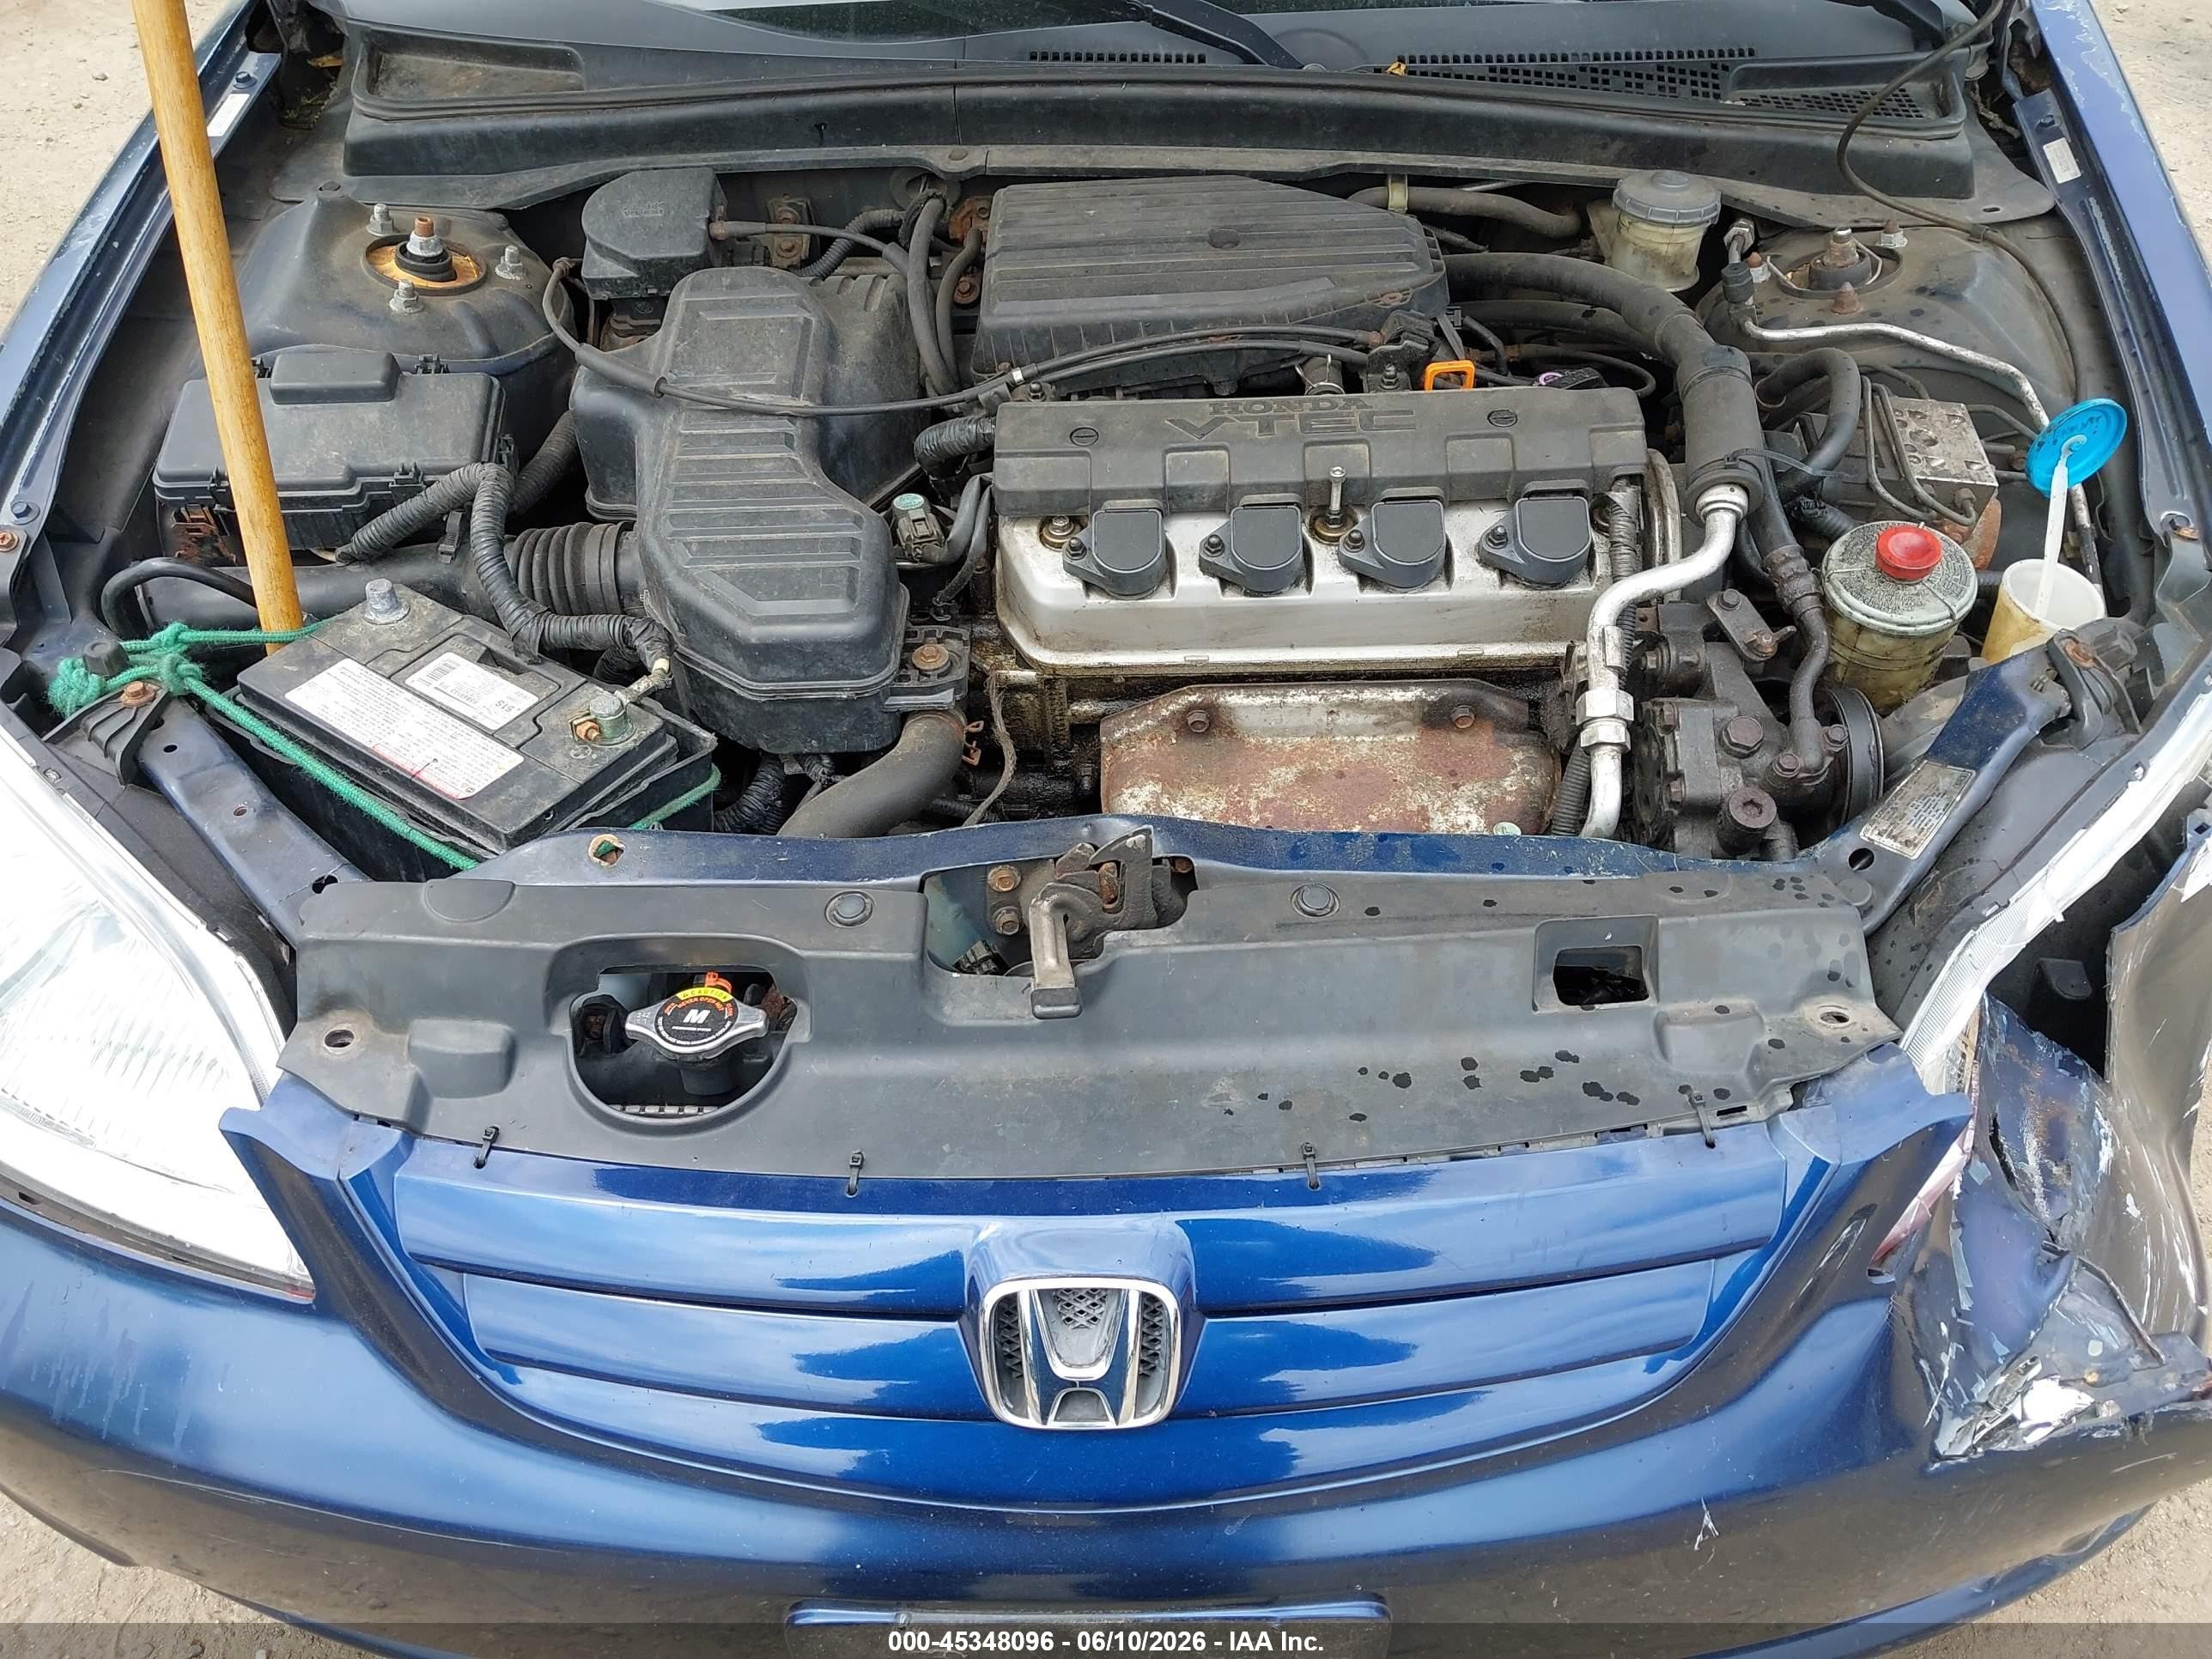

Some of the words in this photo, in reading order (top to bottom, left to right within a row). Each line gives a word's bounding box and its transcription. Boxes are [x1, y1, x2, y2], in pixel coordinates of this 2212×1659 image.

[1208, 398, 1372, 416] HONDA
[1165, 410, 1416, 440] VTEC
[690, 989, 728, 999] CAUTION
